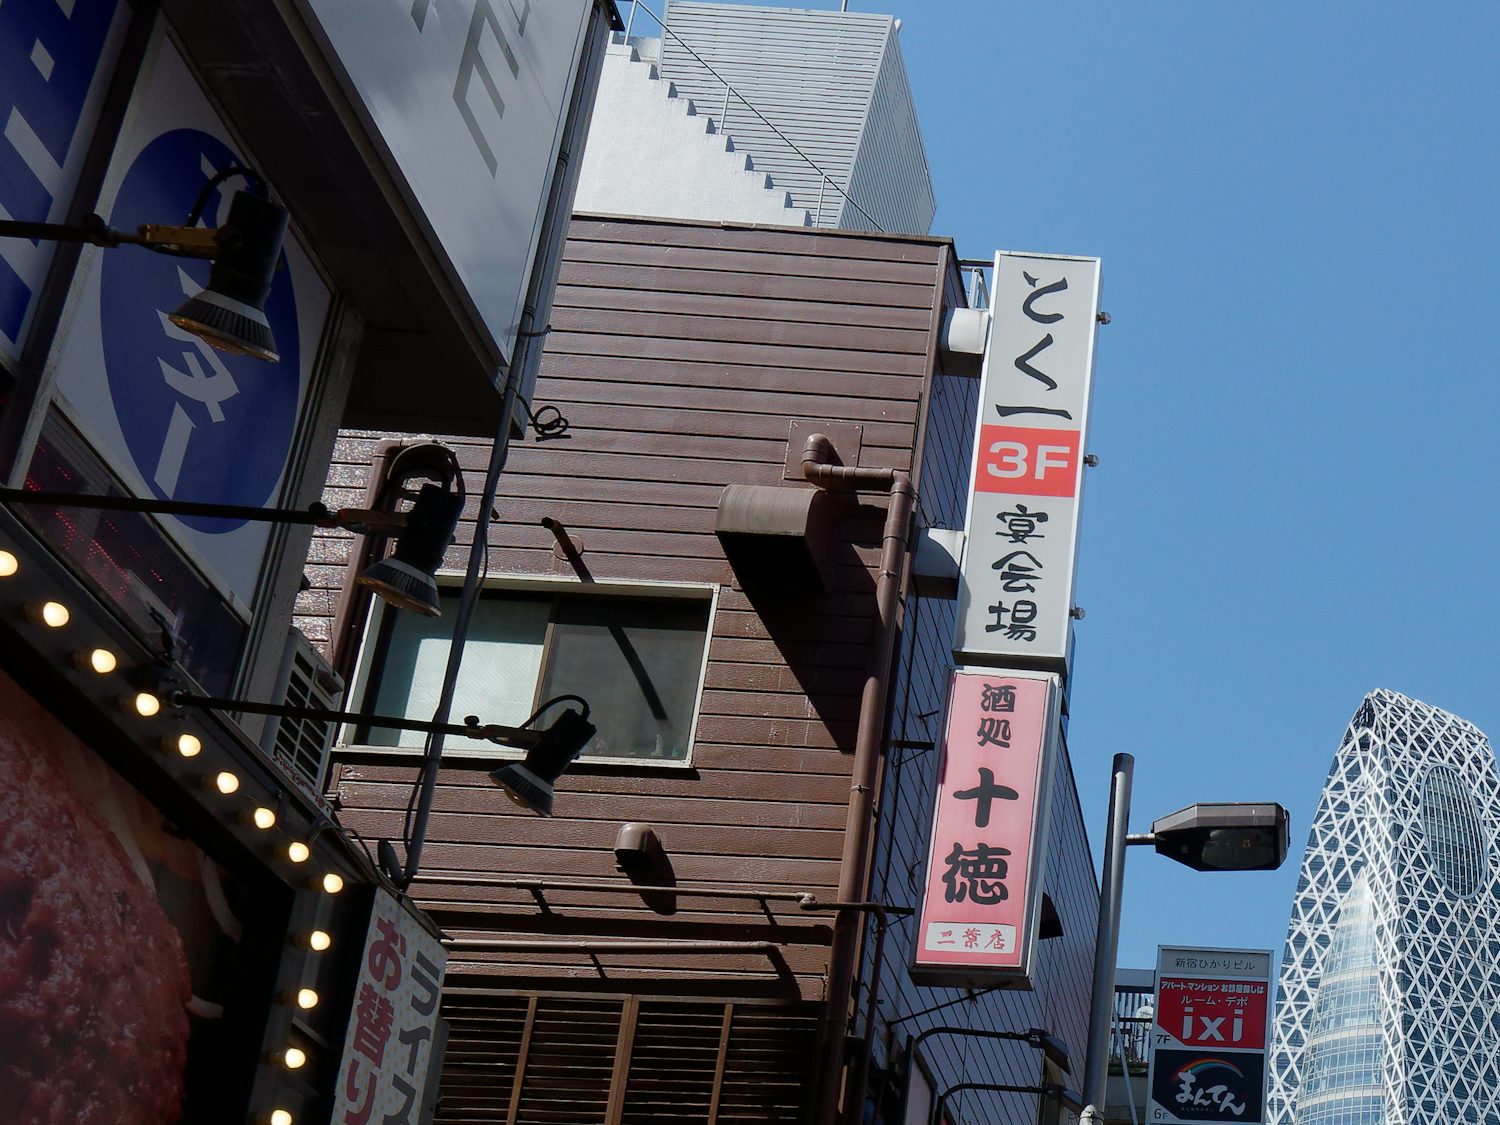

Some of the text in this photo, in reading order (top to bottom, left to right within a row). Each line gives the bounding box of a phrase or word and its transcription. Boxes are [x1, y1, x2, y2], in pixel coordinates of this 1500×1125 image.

[987, 441, 1070, 480] 3F
[985, 504, 1049, 642] 宴会場
[942, 683, 1019, 905] 酒処 十徳
[937, 928, 1005, 950] 二葉店
[1175, 957, 1255, 971] 新宿ひかりビル
[1156, 1033, 1171, 1045] 7F
[1182, 1006, 1243, 1041] ixi
[1175, 1070, 1245, 1116] まんてん
[1153, 1108, 1168, 1120] 6F
